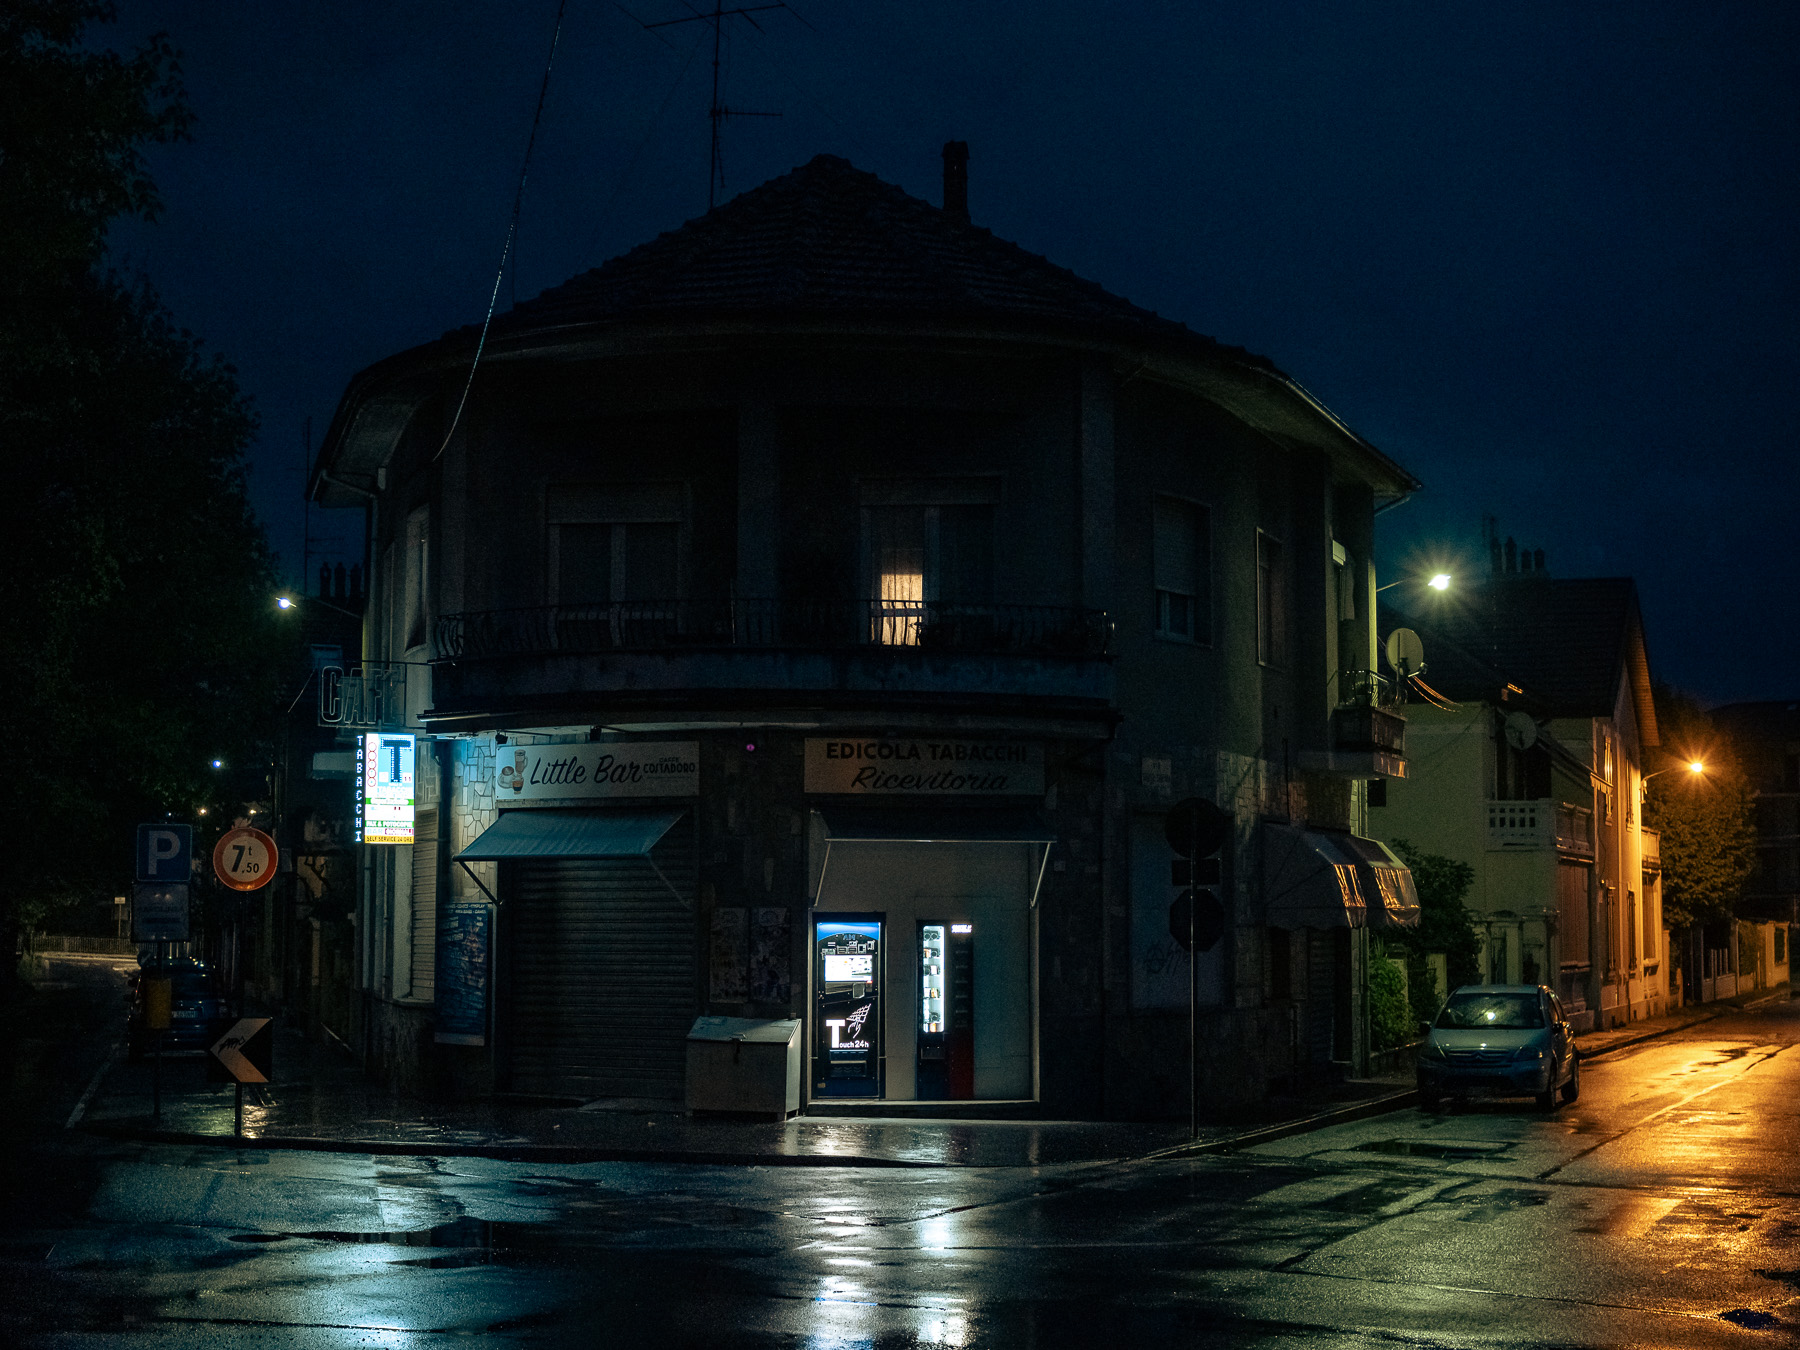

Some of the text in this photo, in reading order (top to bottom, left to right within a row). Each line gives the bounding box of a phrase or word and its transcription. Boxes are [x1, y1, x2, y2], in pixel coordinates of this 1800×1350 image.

[380, 738, 413, 782] T
[825, 742, 1026, 762] EDICOLA TABACCHI
[530, 754, 642, 785] Little Bar
[643, 762, 695, 774] COSTADORO
[850, 766, 1007, 790] Ricevitoria
[354, 735, 364, 842] TABACCHI
[148, 830, 181, 875] P
[855, 1040, 869, 1048] 24h
